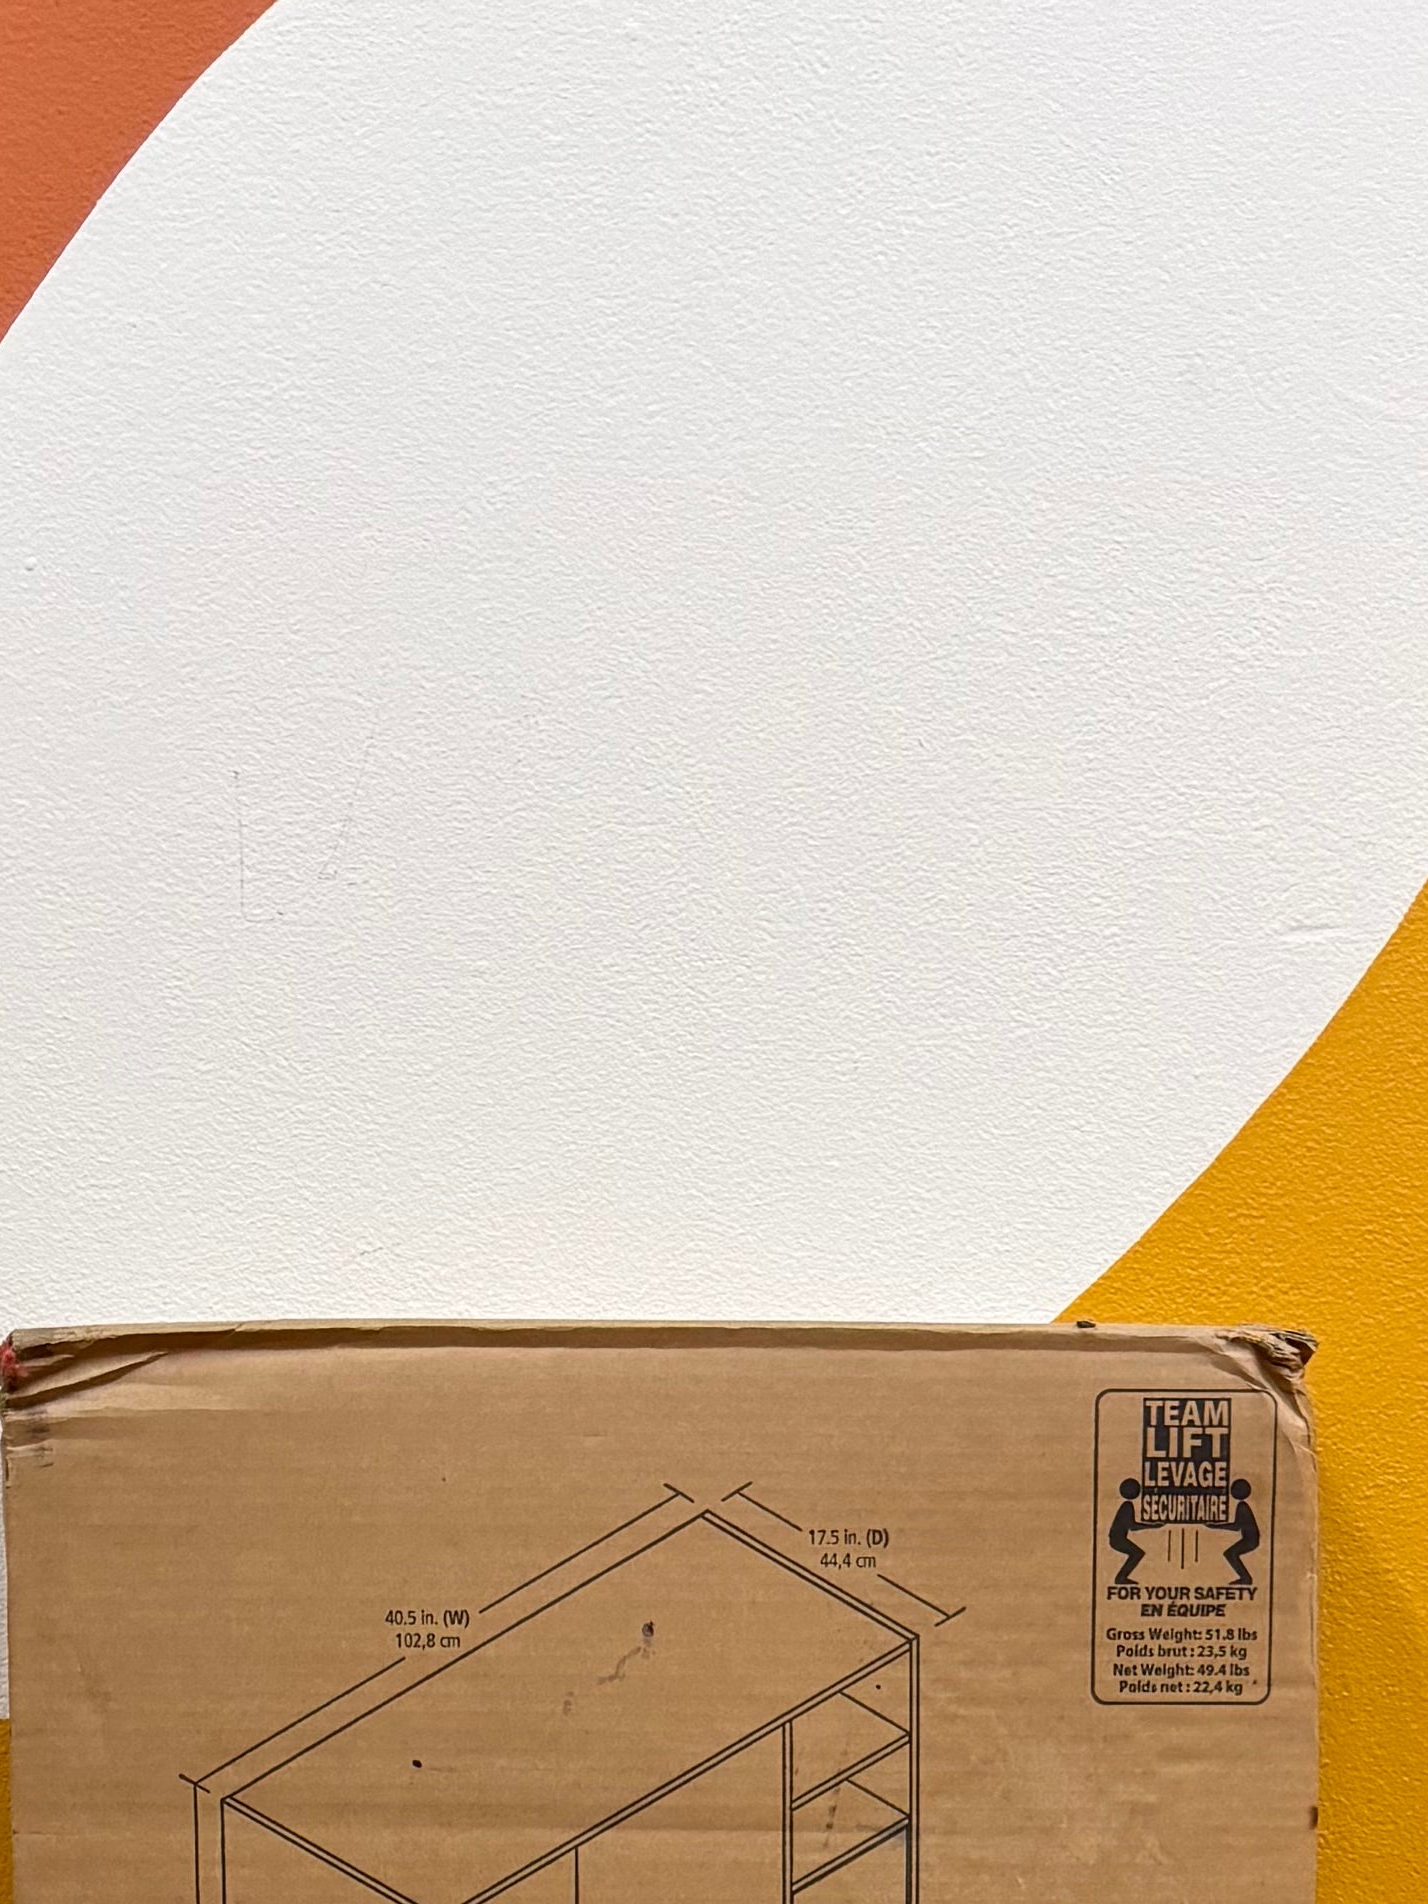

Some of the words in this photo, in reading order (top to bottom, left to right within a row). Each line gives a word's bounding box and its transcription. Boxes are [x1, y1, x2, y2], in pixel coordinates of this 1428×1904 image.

[1146, 1401, 1228, 1426] TEAM
[1147, 1427, 1228, 1457] LIFT
[1144, 1462, 1227, 1487] LEVAGE
[1143, 1488, 1226, 1520] SÉCURITAIRE
[809, 1529, 839, 1545] 17.5
[844, 1528, 861, 1545] in.
[867, 1528, 889, 1548] (D)
[820, 1553, 851, 1570] 44,4
[856, 1556, 876, 1568] cm
[1107, 1586, 1140, 1600] FOR
[1146, 1586, 1190, 1600] YOUR
[1194, 1586, 1257, 1600] SAFETY
[1141, 1604, 1163, 1617] EN
[1167, 1601, 1226, 1617] ÉQUIPE
[385, 1610, 416, 1625] 40.5
[421, 1609, 438, 1625] in.
[443, 1609, 469, 1629] (W)
[396, 1633, 435, 1651] 102,8
[440, 1636, 460, 1648] cm
[1107, 1628, 1144, 1640] Gross
[1149, 1628, 1202, 1643] Weight:
[1205, 1628, 1234, 1640] 51.8
[1238, 1628, 1257, 1640] lbs
[1117, 1645, 1153, 1657] Poids
[1197, 1646, 1226, 1659] 23,5
[1230, 1645, 1247, 1660] kg
[1113, 1664, 1137, 1676] Net
[1141, 1664, 1194, 1678] Weight:
[1197, 1664, 1226, 1676] 49.4
[1230, 1664, 1249, 1676] lbs
[1120, 1681, 1157, 1693] Poids
[1193, 1681, 1222, 1694] 22,4
[1226, 1681, 1242, 1695] kg
